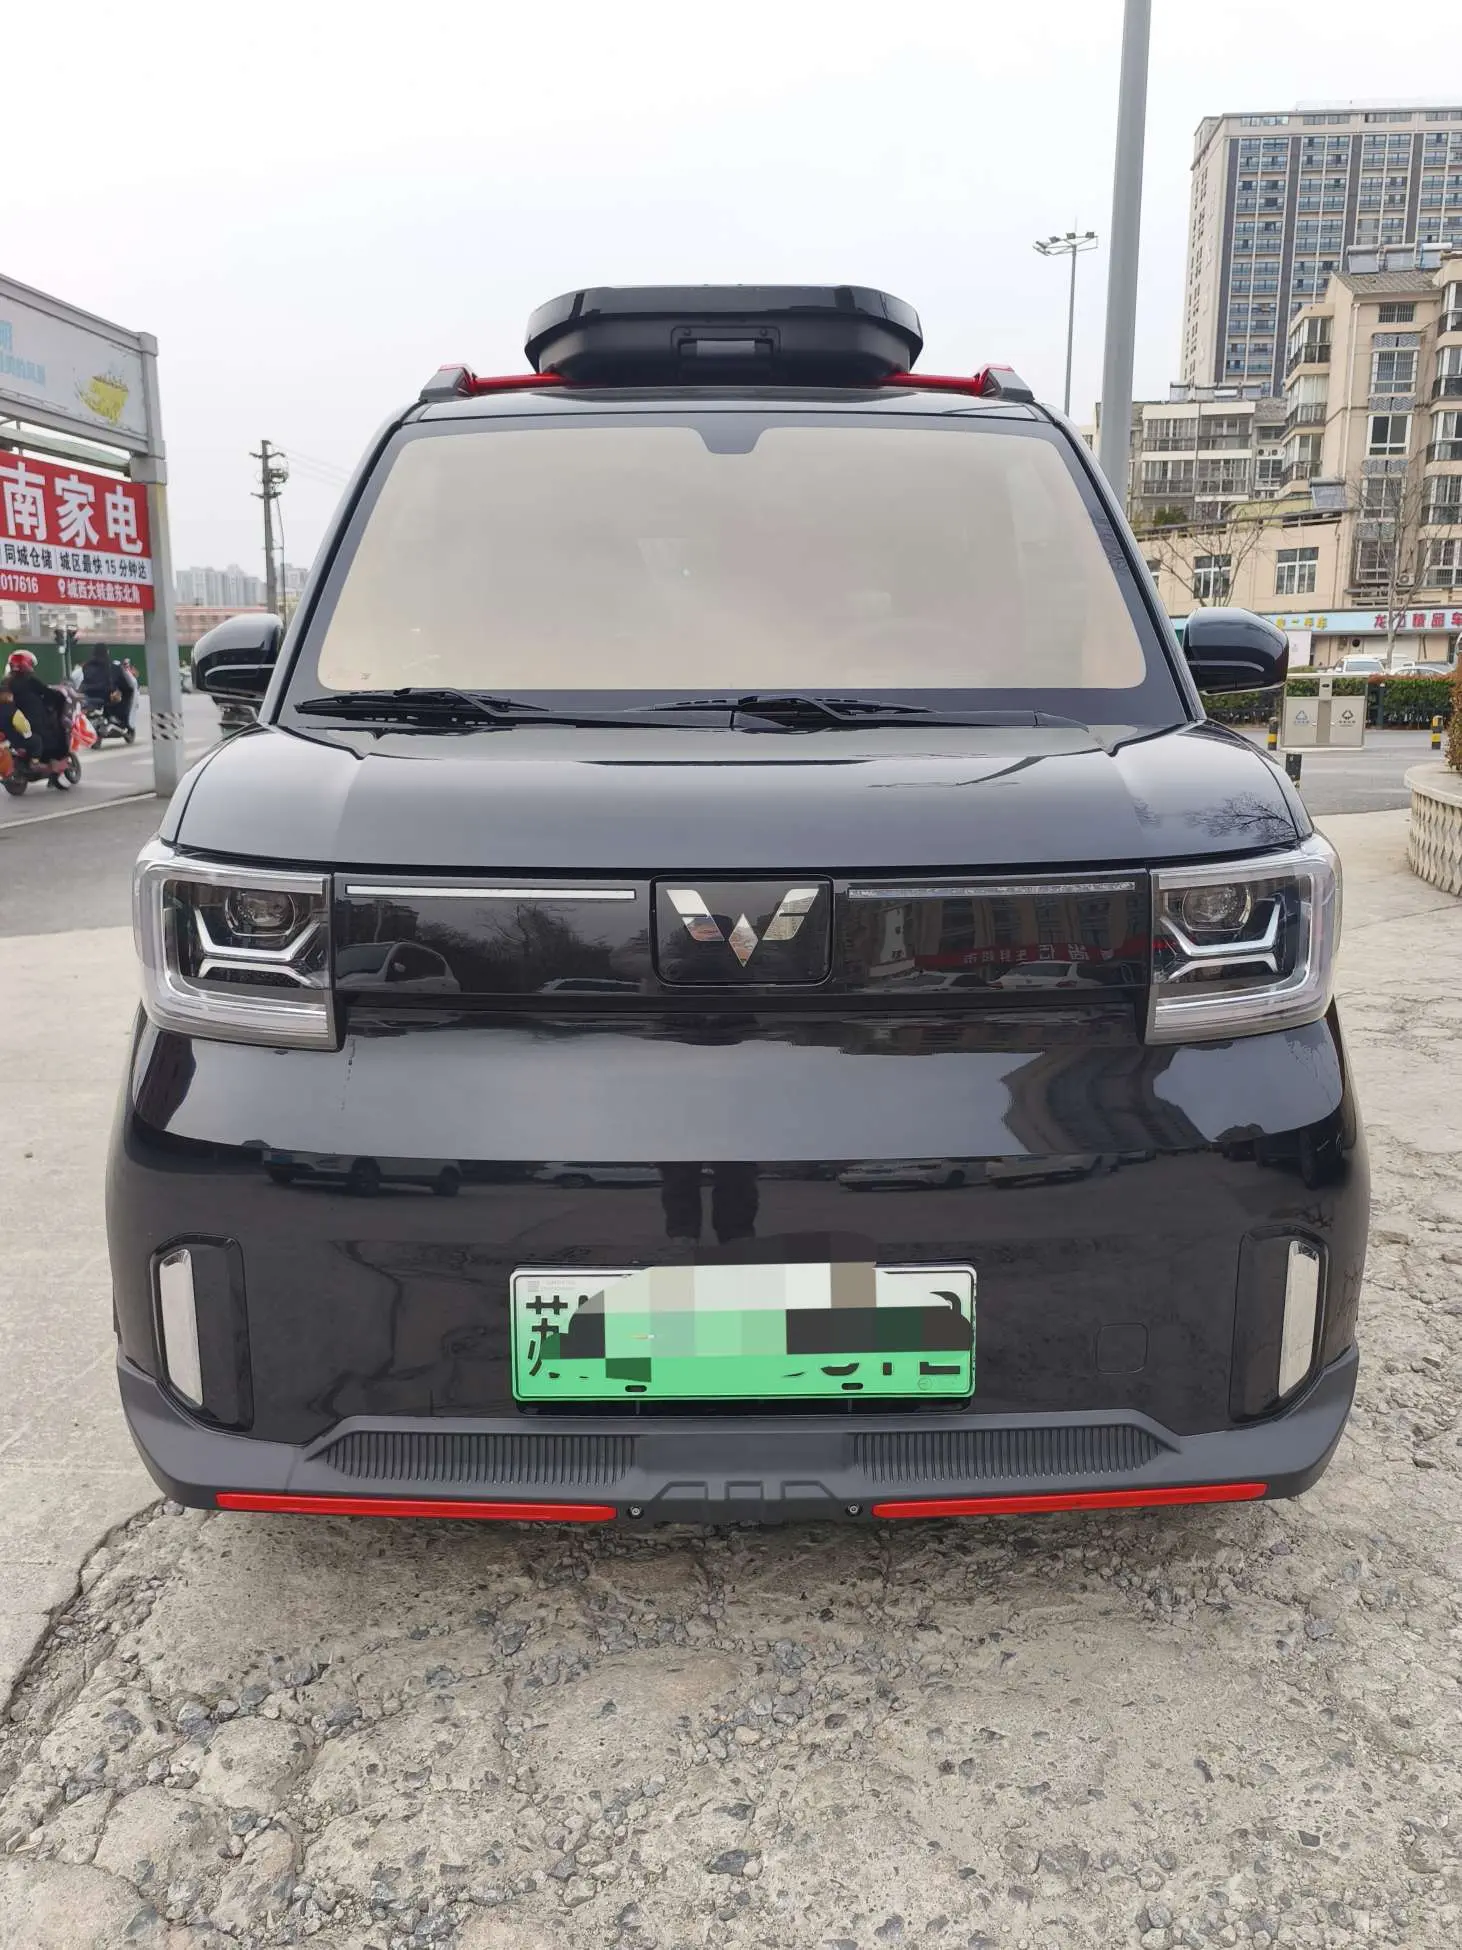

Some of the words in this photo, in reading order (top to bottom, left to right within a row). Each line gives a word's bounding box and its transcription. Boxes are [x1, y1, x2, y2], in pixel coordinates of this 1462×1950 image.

[0, 461, 143, 553] 南家电
[4, 543, 53, 569] 同城仓储
